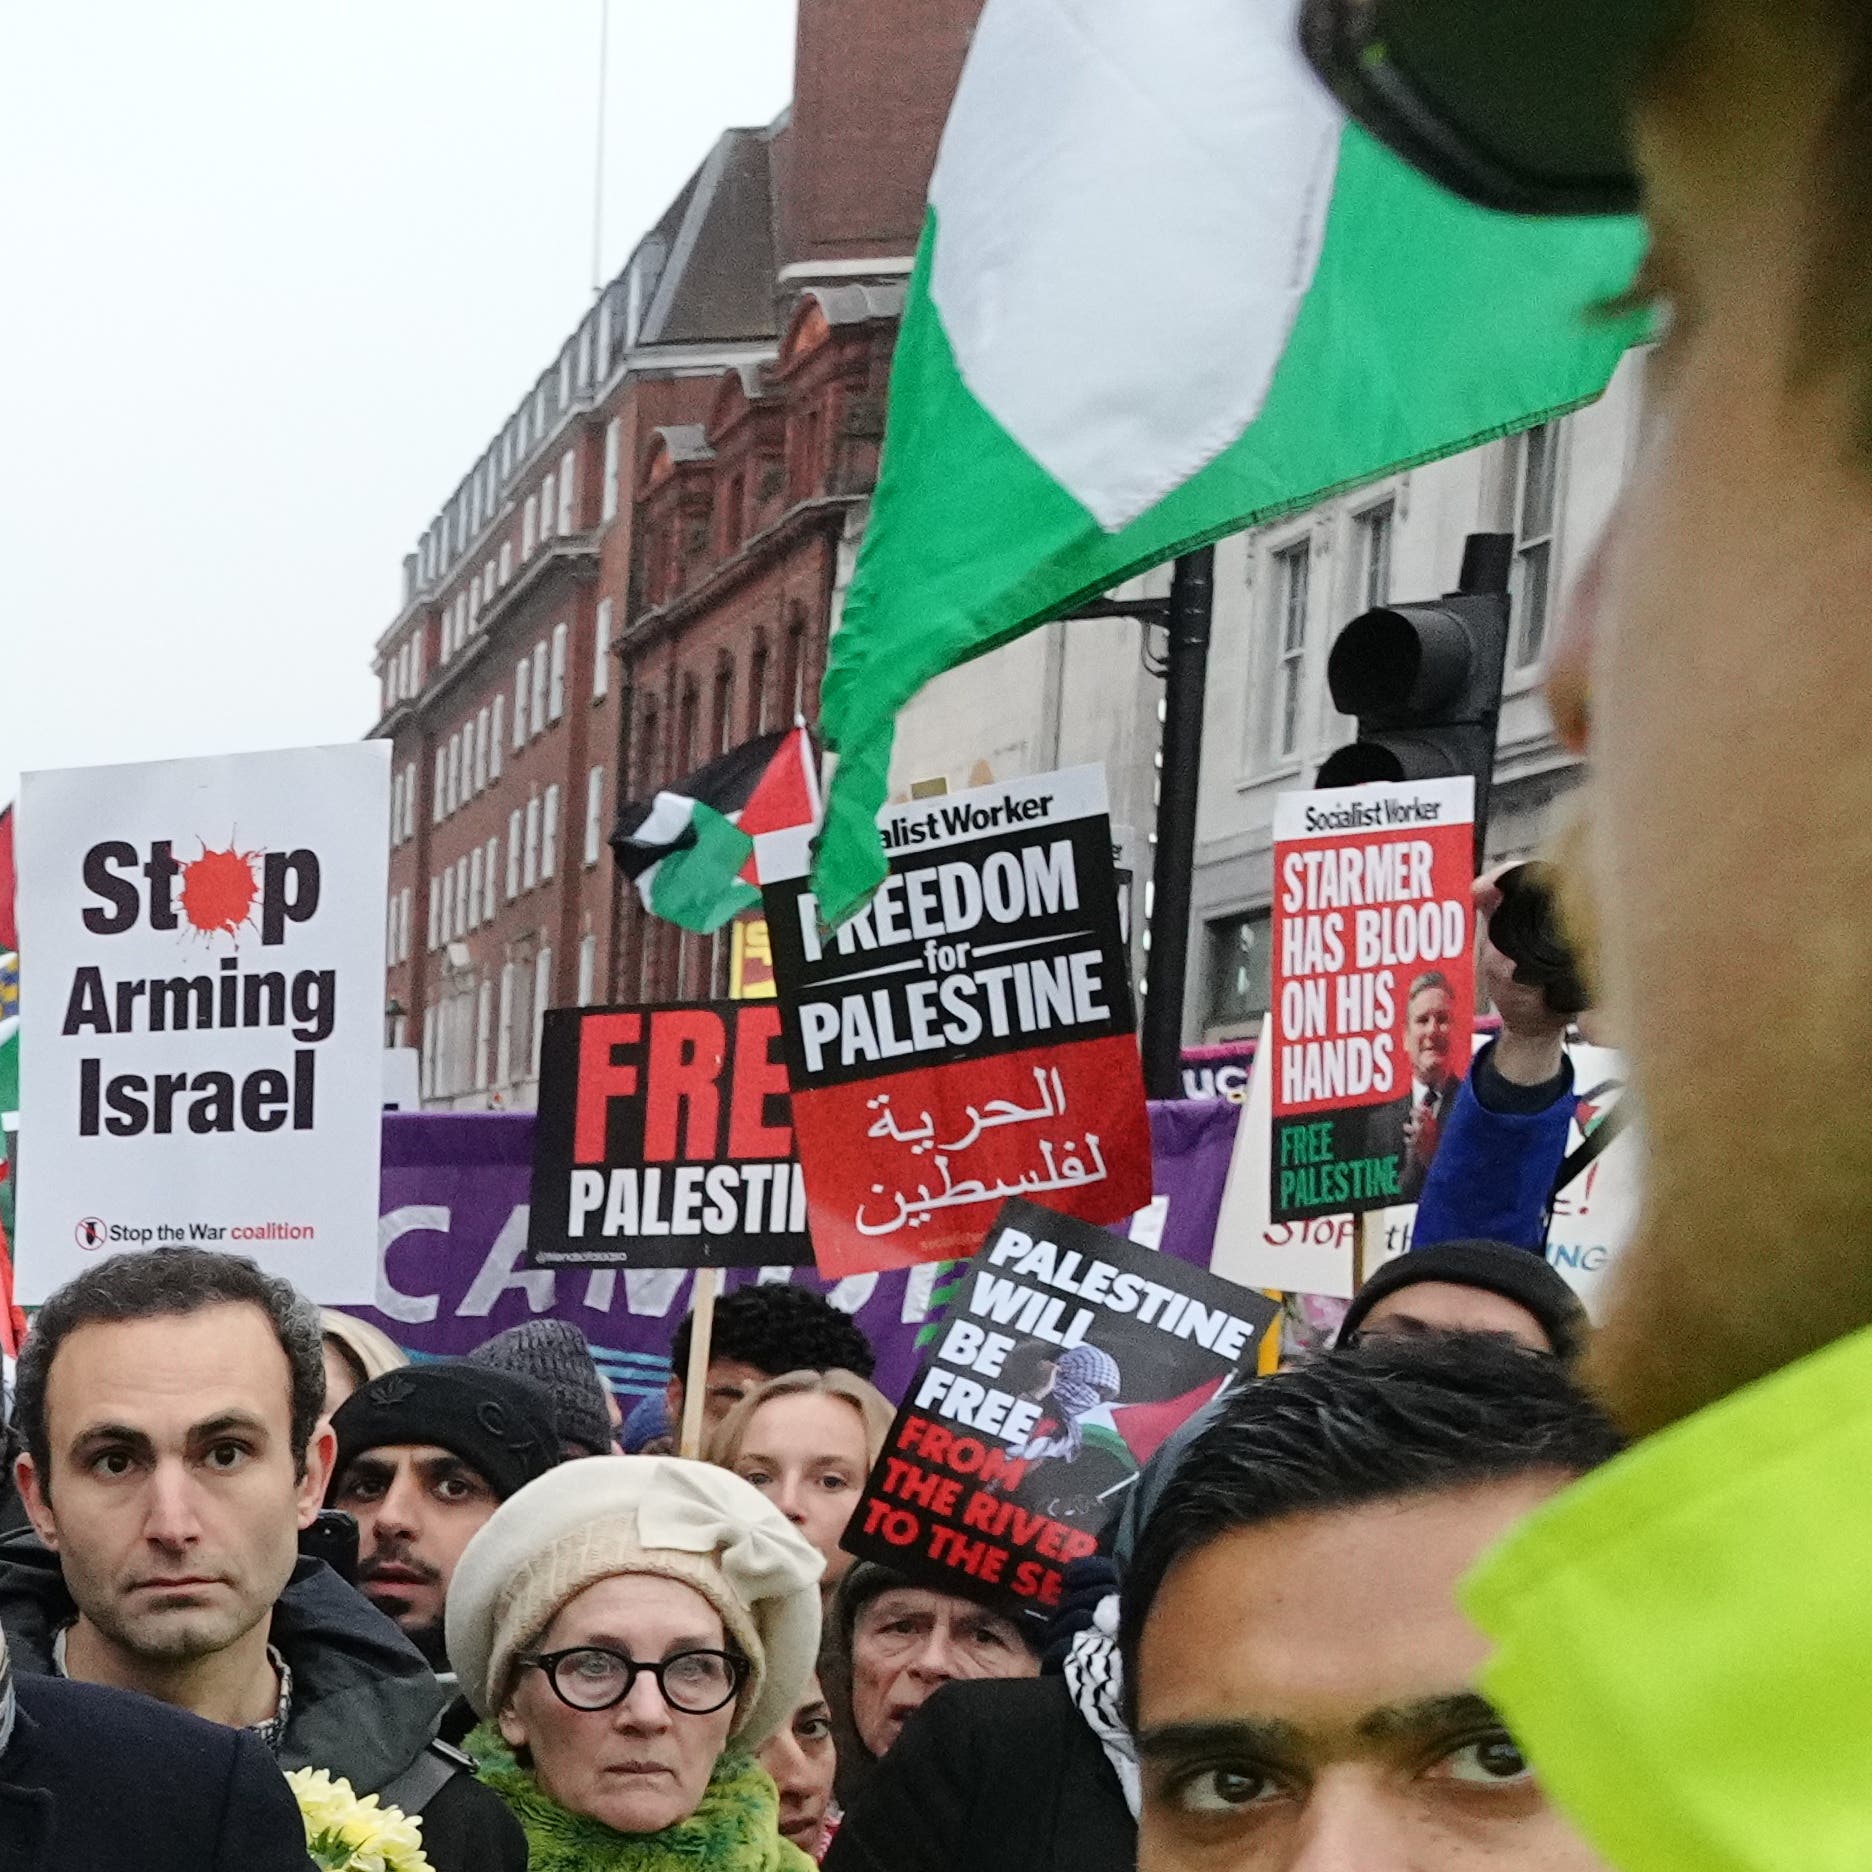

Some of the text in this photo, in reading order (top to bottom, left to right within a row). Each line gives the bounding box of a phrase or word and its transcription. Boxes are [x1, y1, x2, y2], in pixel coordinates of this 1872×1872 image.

[879, 793, 1054, 849] alist Worker
[1305, 798, 1442, 832] Socialist Worker
[1281, 840, 1434, 914] STARMER
[923, 940, 972, 974] for
[1281, 900, 1466, 977] HAS BLOOD
[61, 957, 337, 1043] Arming
[797, 949, 1111, 1073] PALESTINE
[1281, 970, 1395, 1042] ON HIS
[78, 1048, 316, 1137] Israel
[572, 1005, 795, 1165] FRE
[1281, 1033, 1394, 1104] HANDS
[865, 1065, 1067, 1155] الحرية
[1279, 1120, 1335, 1168] FREE
[567, 1163, 807, 1238] PALESTI
[855, 1131, 1107, 1237] لفلسطين
[1279, 1155, 1403, 1210] PALESTINE
[110, 1223, 315, 1246] Stop the War coalition
[967, 1270, 1096, 1350] WILL
[986, 1226, 1256, 1362] PALESTINE
[937, 1318, 1017, 1379] BE
[913, 1366, 1045, 1446] FREE
[882, 1456, 964, 1517] THE
[896, 1414, 1032, 1492] FROM
[862, 1497, 1065, 1607] TO THE SE
